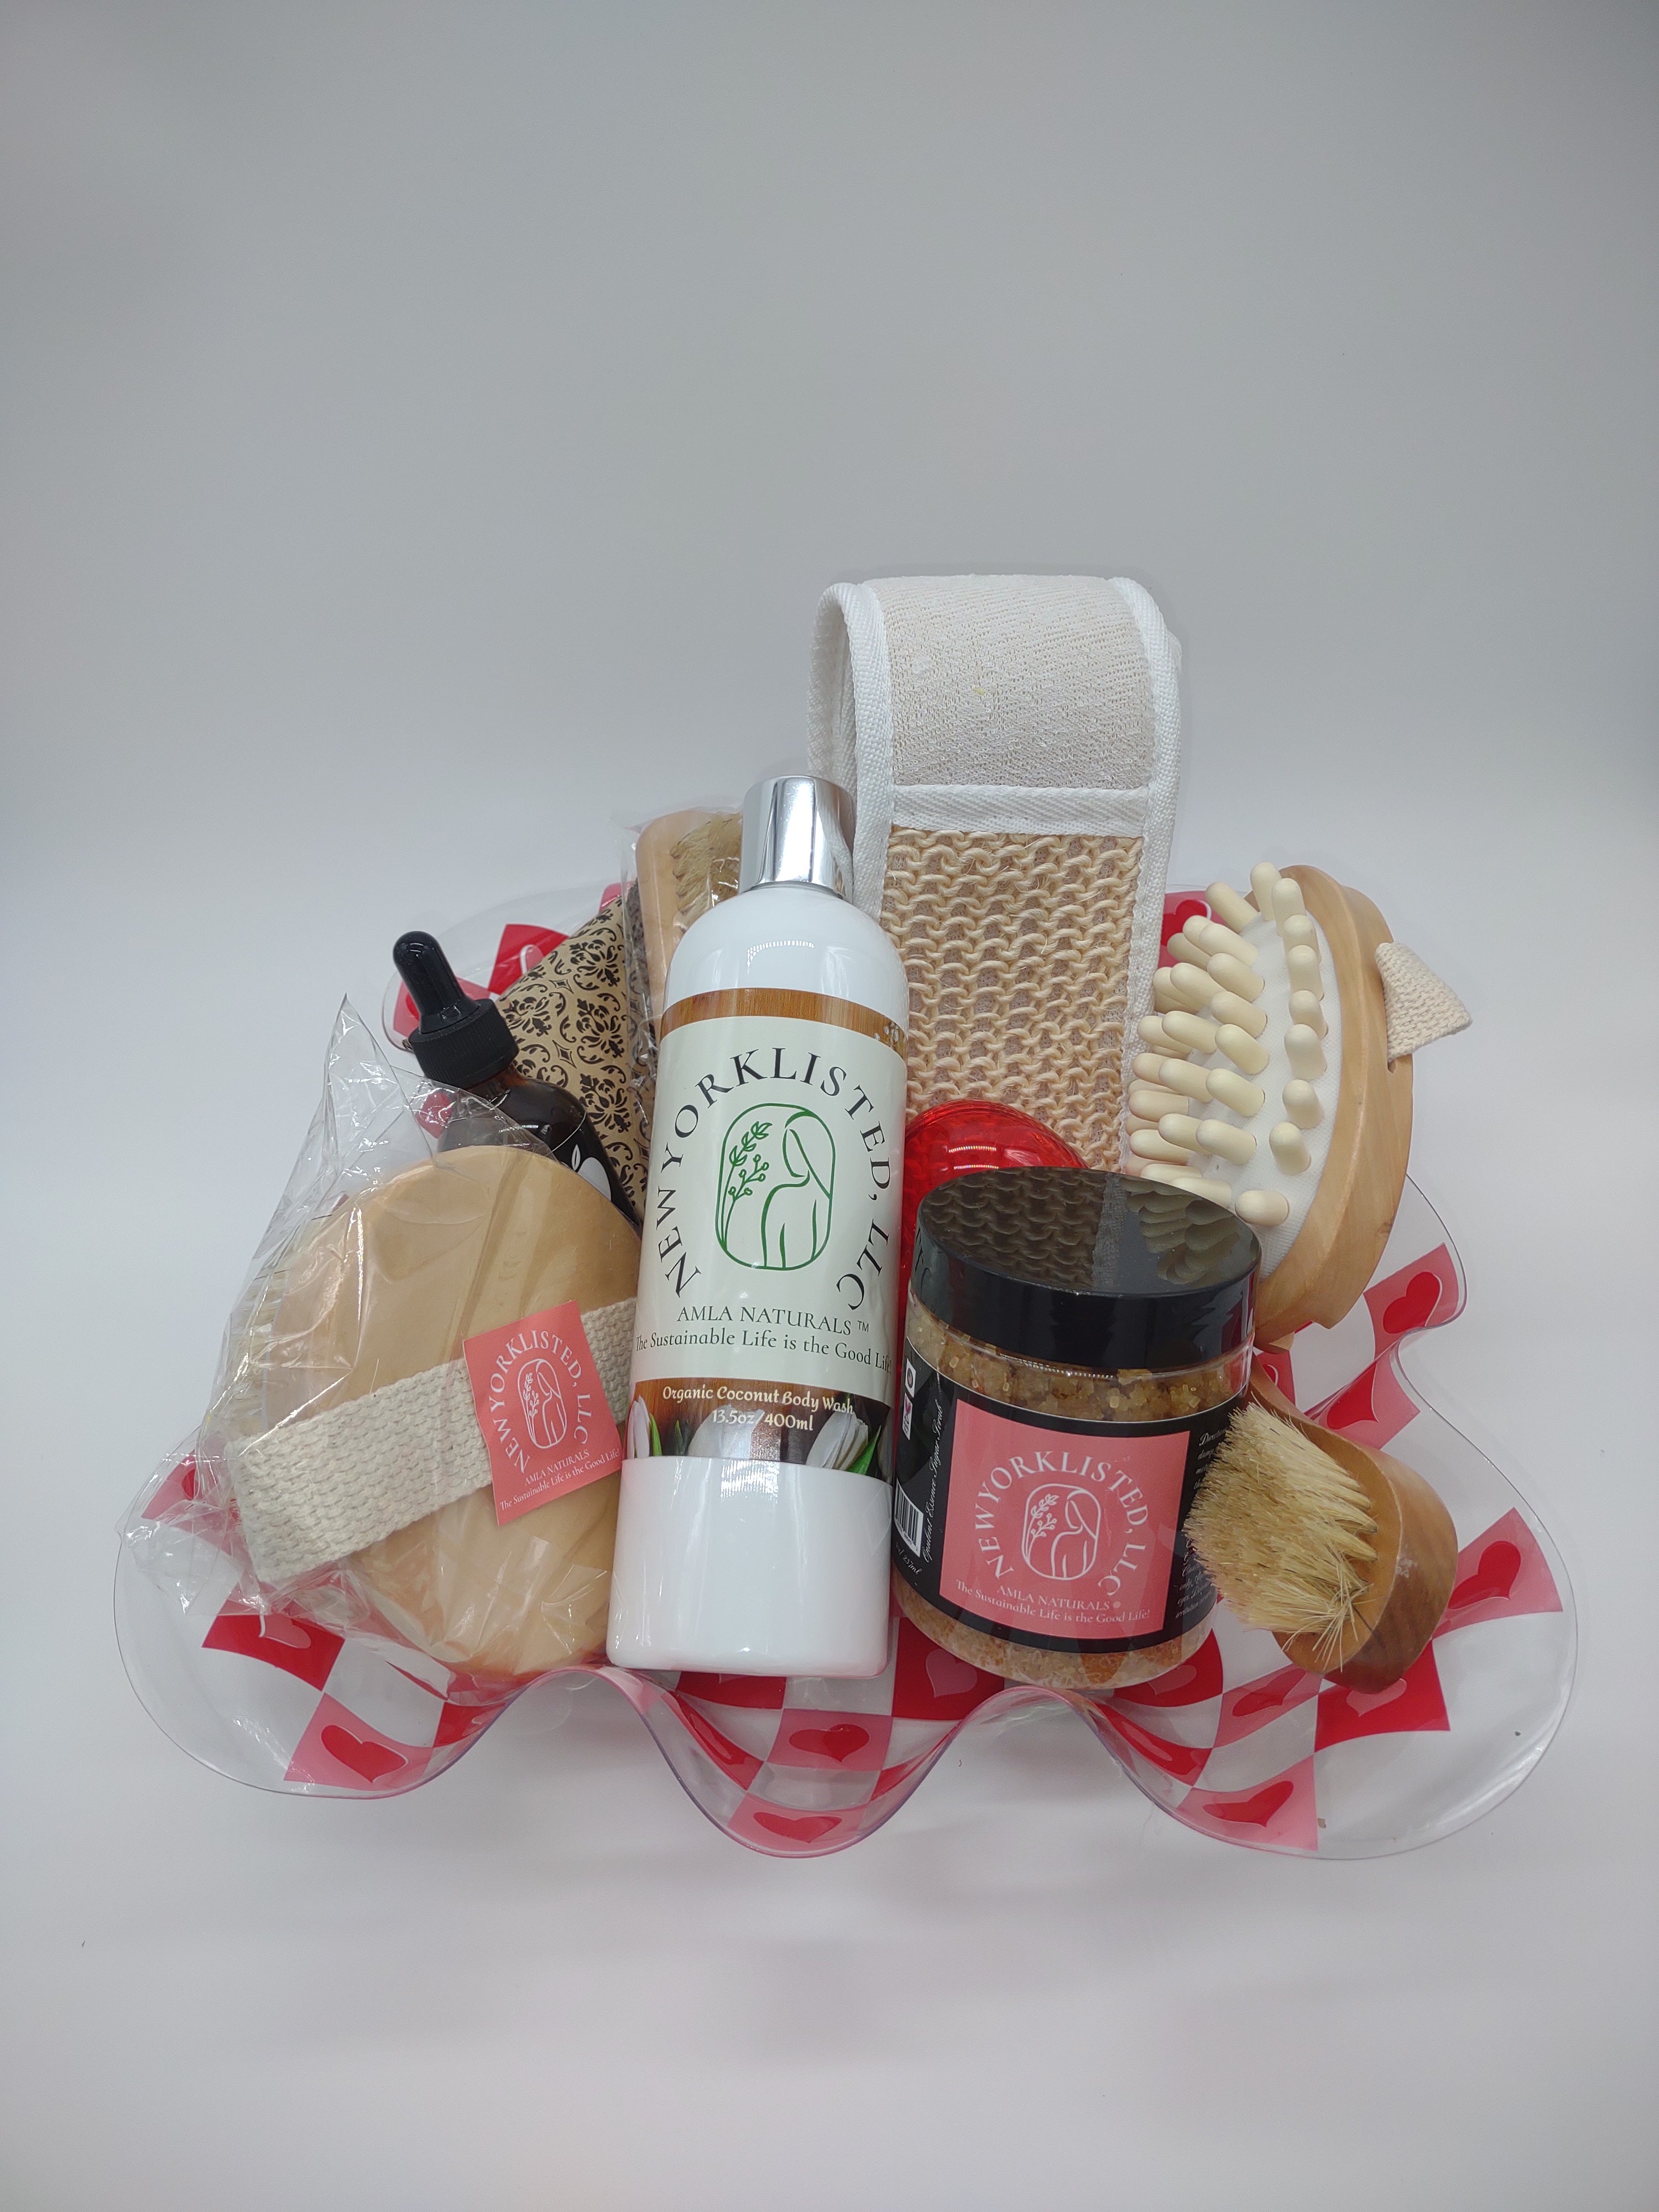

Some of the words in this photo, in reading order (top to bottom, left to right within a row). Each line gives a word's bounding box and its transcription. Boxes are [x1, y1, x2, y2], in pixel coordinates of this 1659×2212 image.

[836, 1218, 889, 1311] LLC
[677, 1306, 733, 1321] AMLA
[740, 1306, 851, 1335] NATURALS
[637, 1334, 648, 1351] The
[650, 1327, 735, 1348] Sustainable
[742, 1329, 776, 1347] Life
[784, 1334, 796, 1349] is
[804, 1335, 829, 1355] the
[835, 1342, 871, 1365] Good
[573, 1393, 592, 1445] LLC
[663, 1384, 713, 1404] Organic
[717, 1386, 779, 1403] Coconut
[781, 1391, 819, 1412] Body
[822, 1396, 853, 1414] Wash
[500, 1500, 512, 1510] The
[514, 1479, 550, 1504] Sustainable
[551, 1475, 565, 1485] Life
[572, 1465, 585, 1476] the
[585, 1455, 606, 1469] Good
[525, 1469, 546, 1486] AMLA
[547, 1449, 590, 1474] NATURALS
[925, 1478, 937, 1518] Essence
[1097, 1543, 1146, 1596] LLC
[956, 1579, 972, 1594] The
[975, 1589, 1036, 1616] Sustainable
[1040, 1608, 1061, 1620] Life
[1064, 1612, 1072, 1621] is
[1076, 1612, 1093, 1622] the
[1096, 1611, 1125, 1623] Good
[1128, 1609, 1150, 1621] Life!
[996, 1585, 1034, 1603] AMLA
[1038, 1595, 1109, 1611] NATURALS
